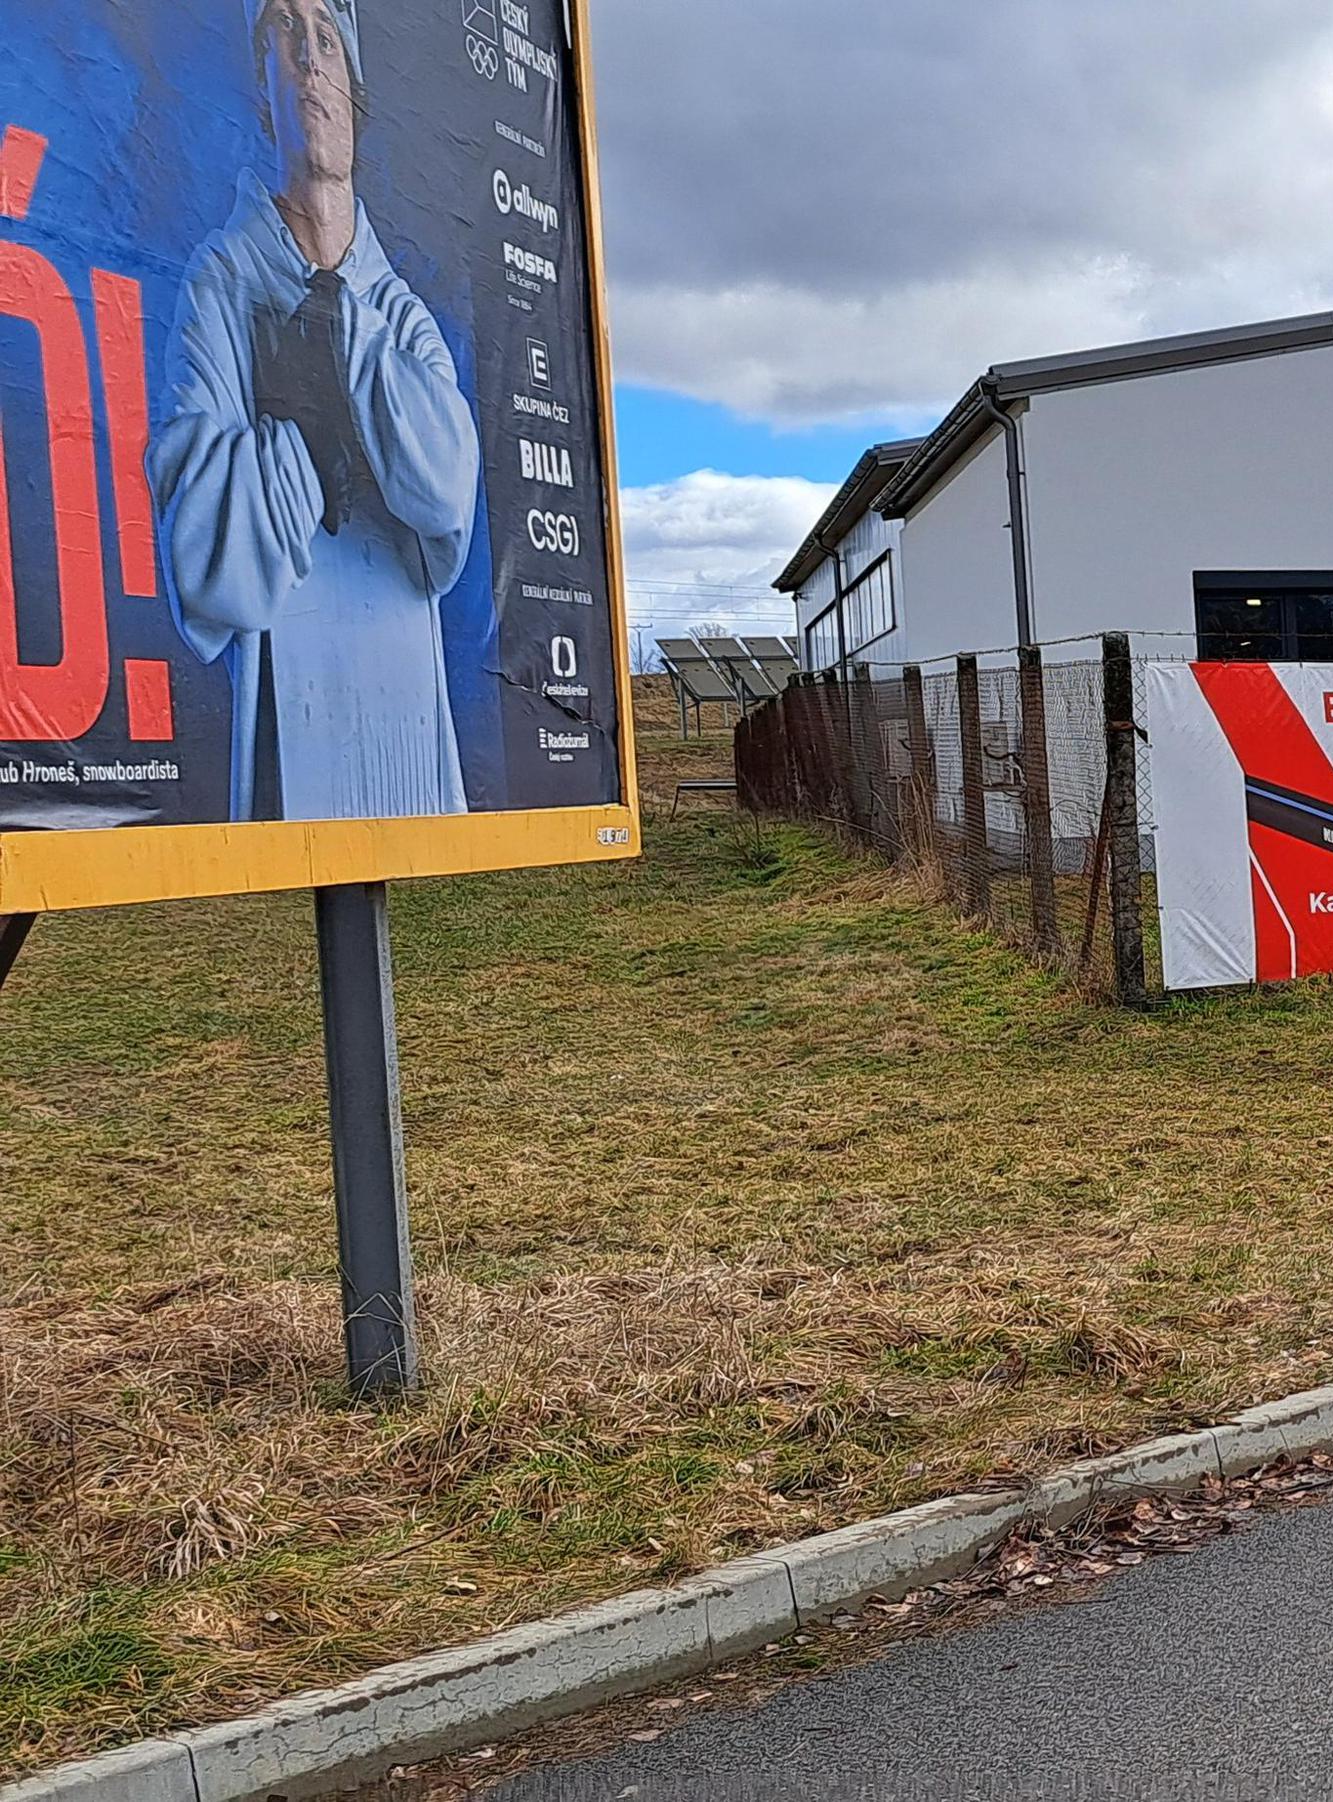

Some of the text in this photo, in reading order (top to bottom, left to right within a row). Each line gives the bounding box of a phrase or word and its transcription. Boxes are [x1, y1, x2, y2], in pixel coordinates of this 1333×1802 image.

[505, 57, 527, 92] TÝM
[514, 184, 559, 233] allwyn
[503, 241, 557, 283] FOSFA
[513, 394, 570, 424] SKUPINA ČEZ
[519, 439, 574, 488] BILLA
[22, 760, 80, 786] Hroneš,
[83, 760, 179, 782] snowboardista
